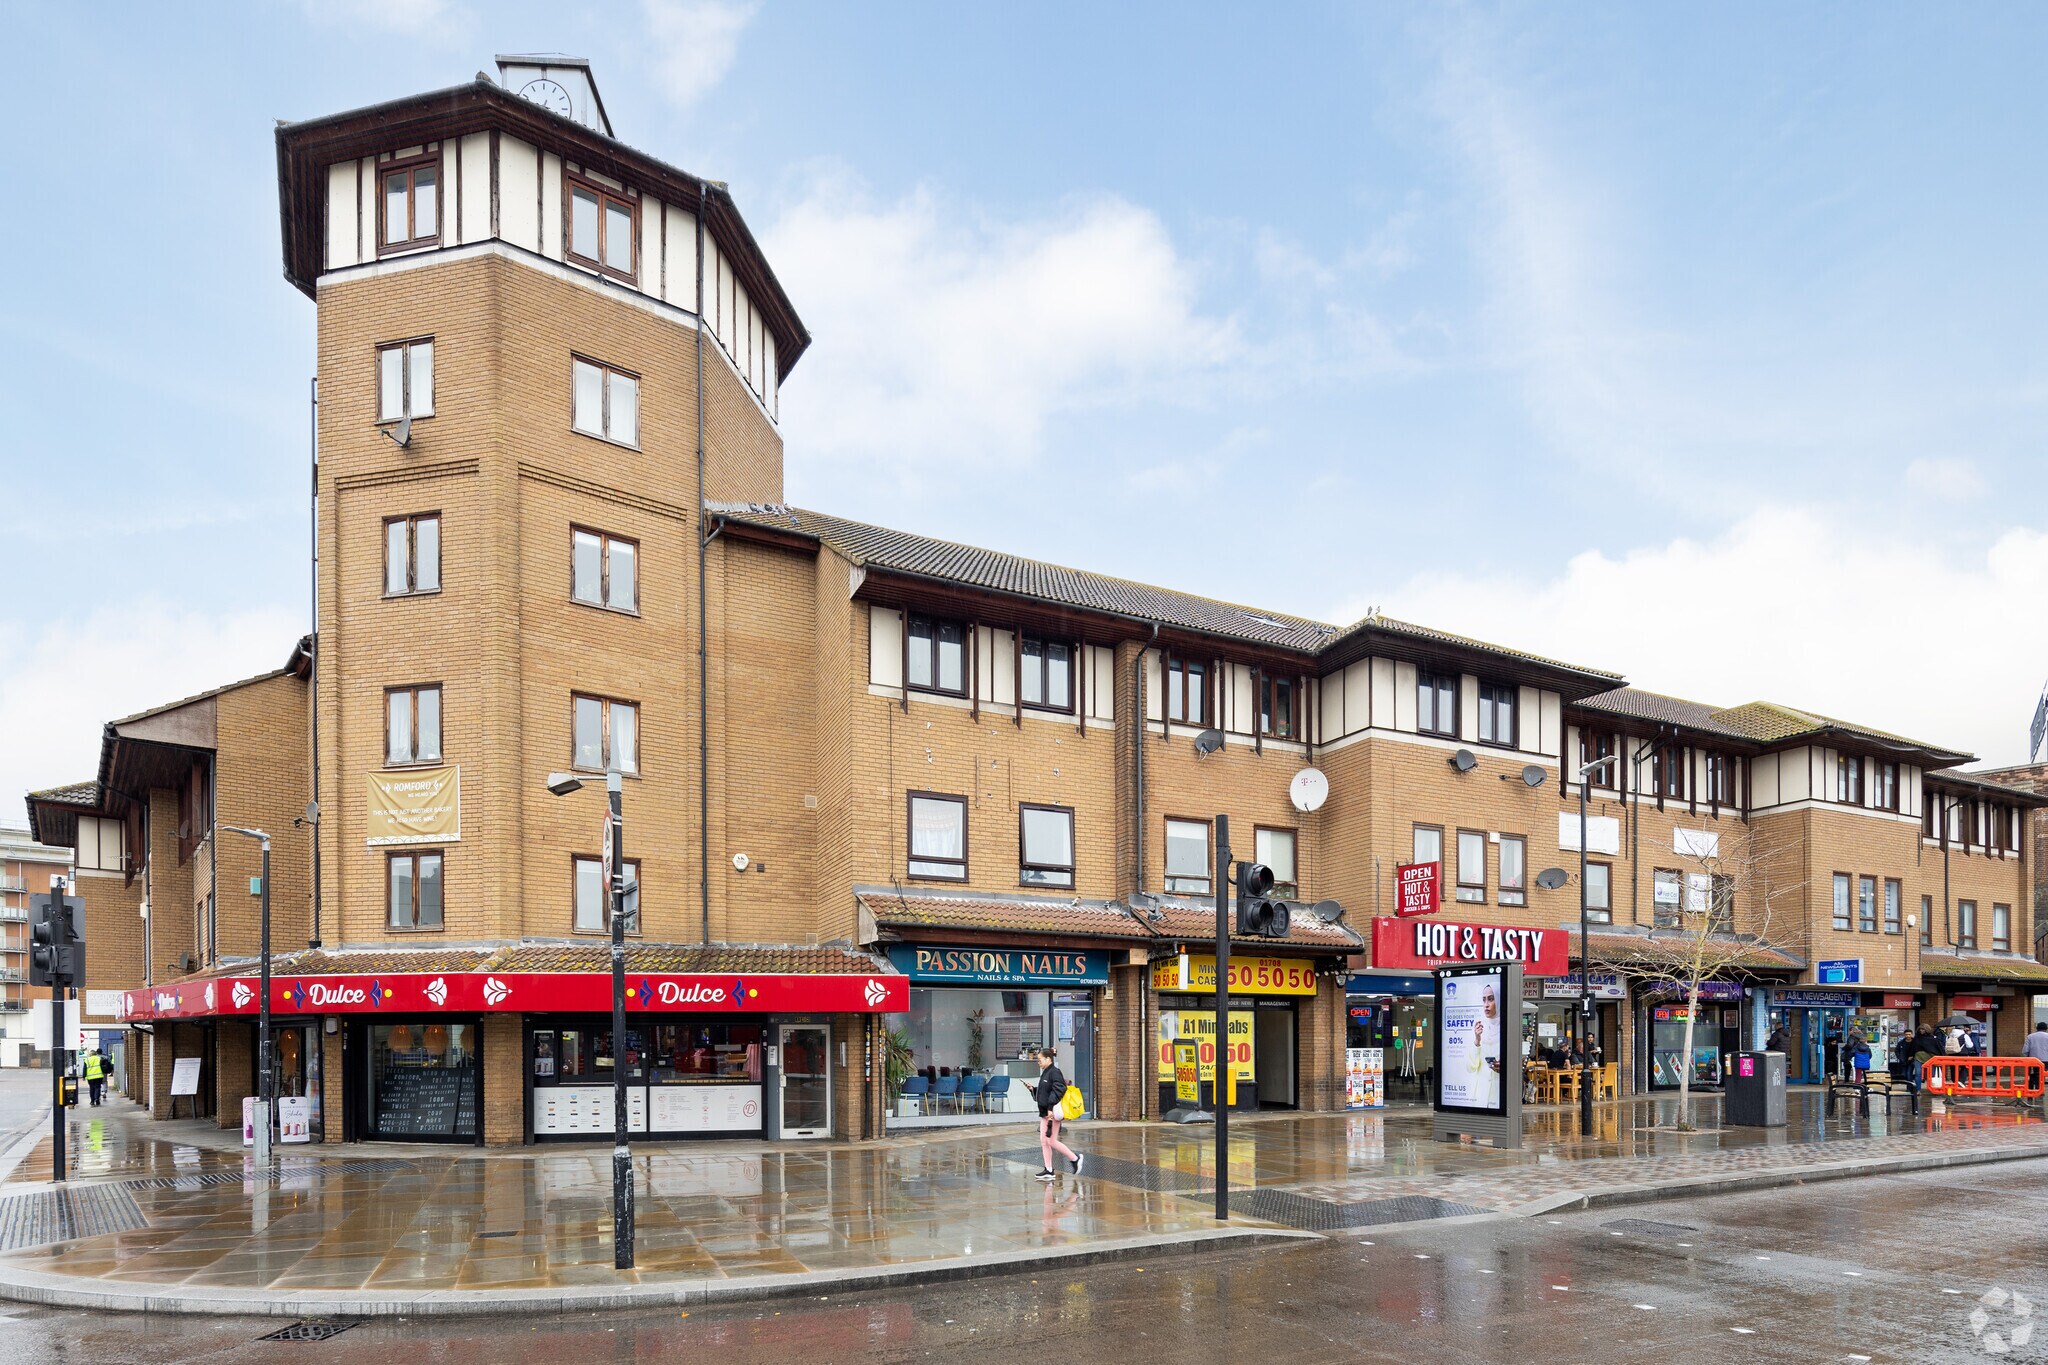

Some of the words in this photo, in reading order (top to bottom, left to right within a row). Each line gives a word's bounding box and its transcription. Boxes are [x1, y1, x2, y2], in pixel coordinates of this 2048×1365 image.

[394, 782, 430, 791] ROMFORD
[1404, 866, 1432, 880] OPEN
[1404, 882, 1422, 895] HOT
[1423, 881, 1430, 892] &
[1405, 893, 1430, 906] TASTY
[1416, 922, 1458, 957] HOT
[1460, 926, 1477, 959] &
[1481, 928, 1544, 962] TASTY
[916, 950, 1010, 972] PASSION
[1021, 954, 1086, 975] NAILS
[1198, 964, 1216, 973] MIN
[1154, 974, 1160, 987] 50
[1162, 974, 1169, 986] 50
[1172, 974, 1178, 986] 50
[1198, 976, 1216, 984] CAB
[1258, 967, 1284, 987] 50
[1288, 968, 1314, 988] 50
[309, 984, 366, 1006] Dulce
[658, 982, 726, 1004] Dulce
[1786, 992, 1802, 1000] A&L
[1803, 992, 1852, 1002] NEWSAGENTS
[1184, 1019, 1196, 1034] A1
[1198, 1019, 1216, 1034] Min
[1228, 1020, 1248, 1034] abs
